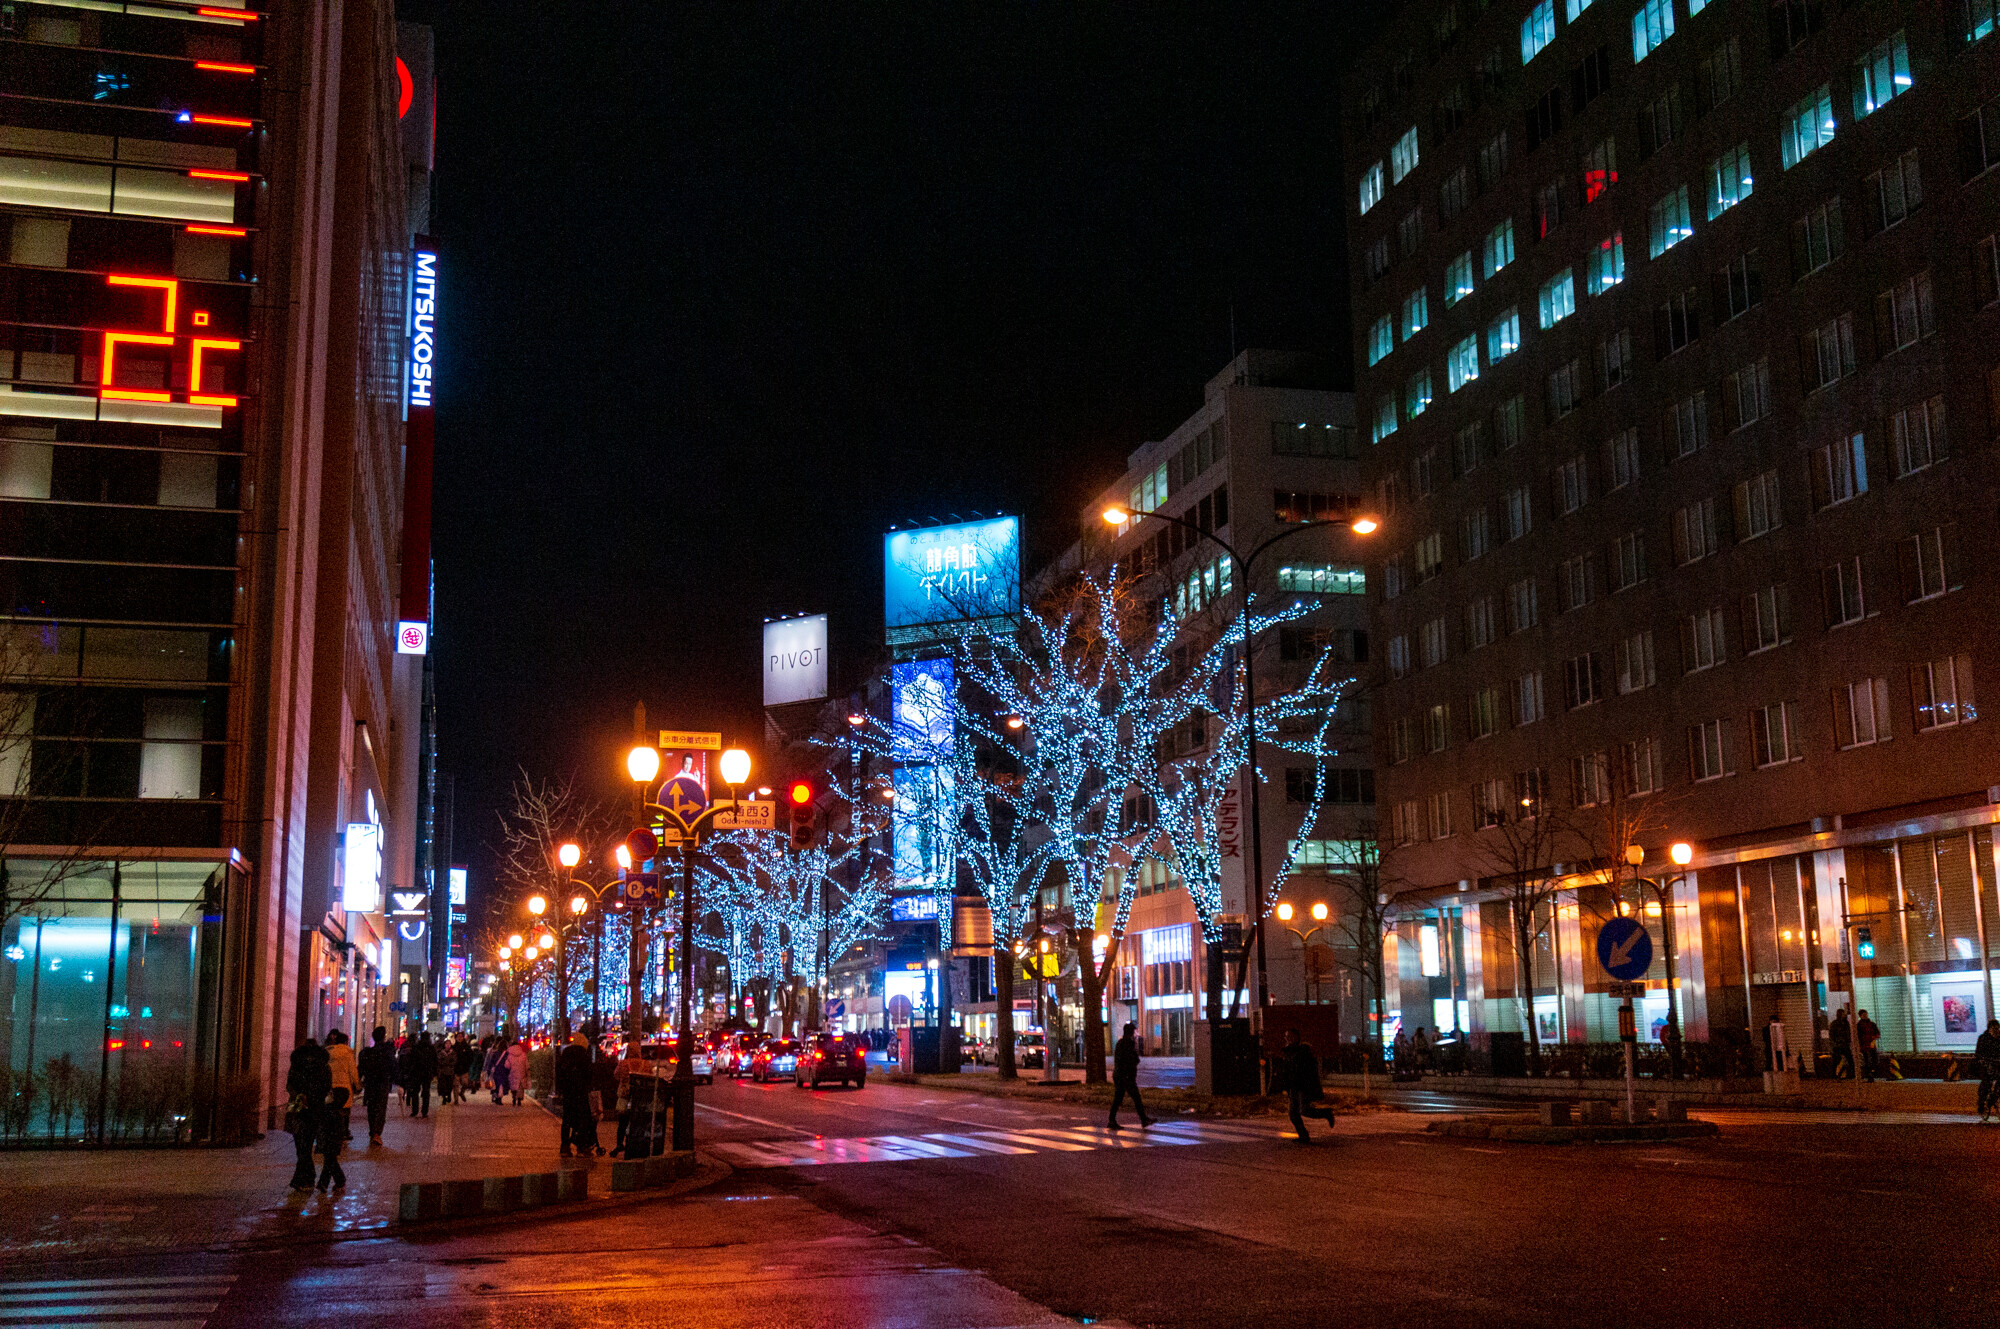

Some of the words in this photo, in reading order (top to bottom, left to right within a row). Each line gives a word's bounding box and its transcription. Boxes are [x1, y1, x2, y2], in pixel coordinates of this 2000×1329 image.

[411, 253, 437, 407] MITSUKOSHI
[926, 542, 977, 573] 龍角散
[770, 647, 822, 673] PIVOT
[663, 735, 717, 746] 歩車分離式信号
